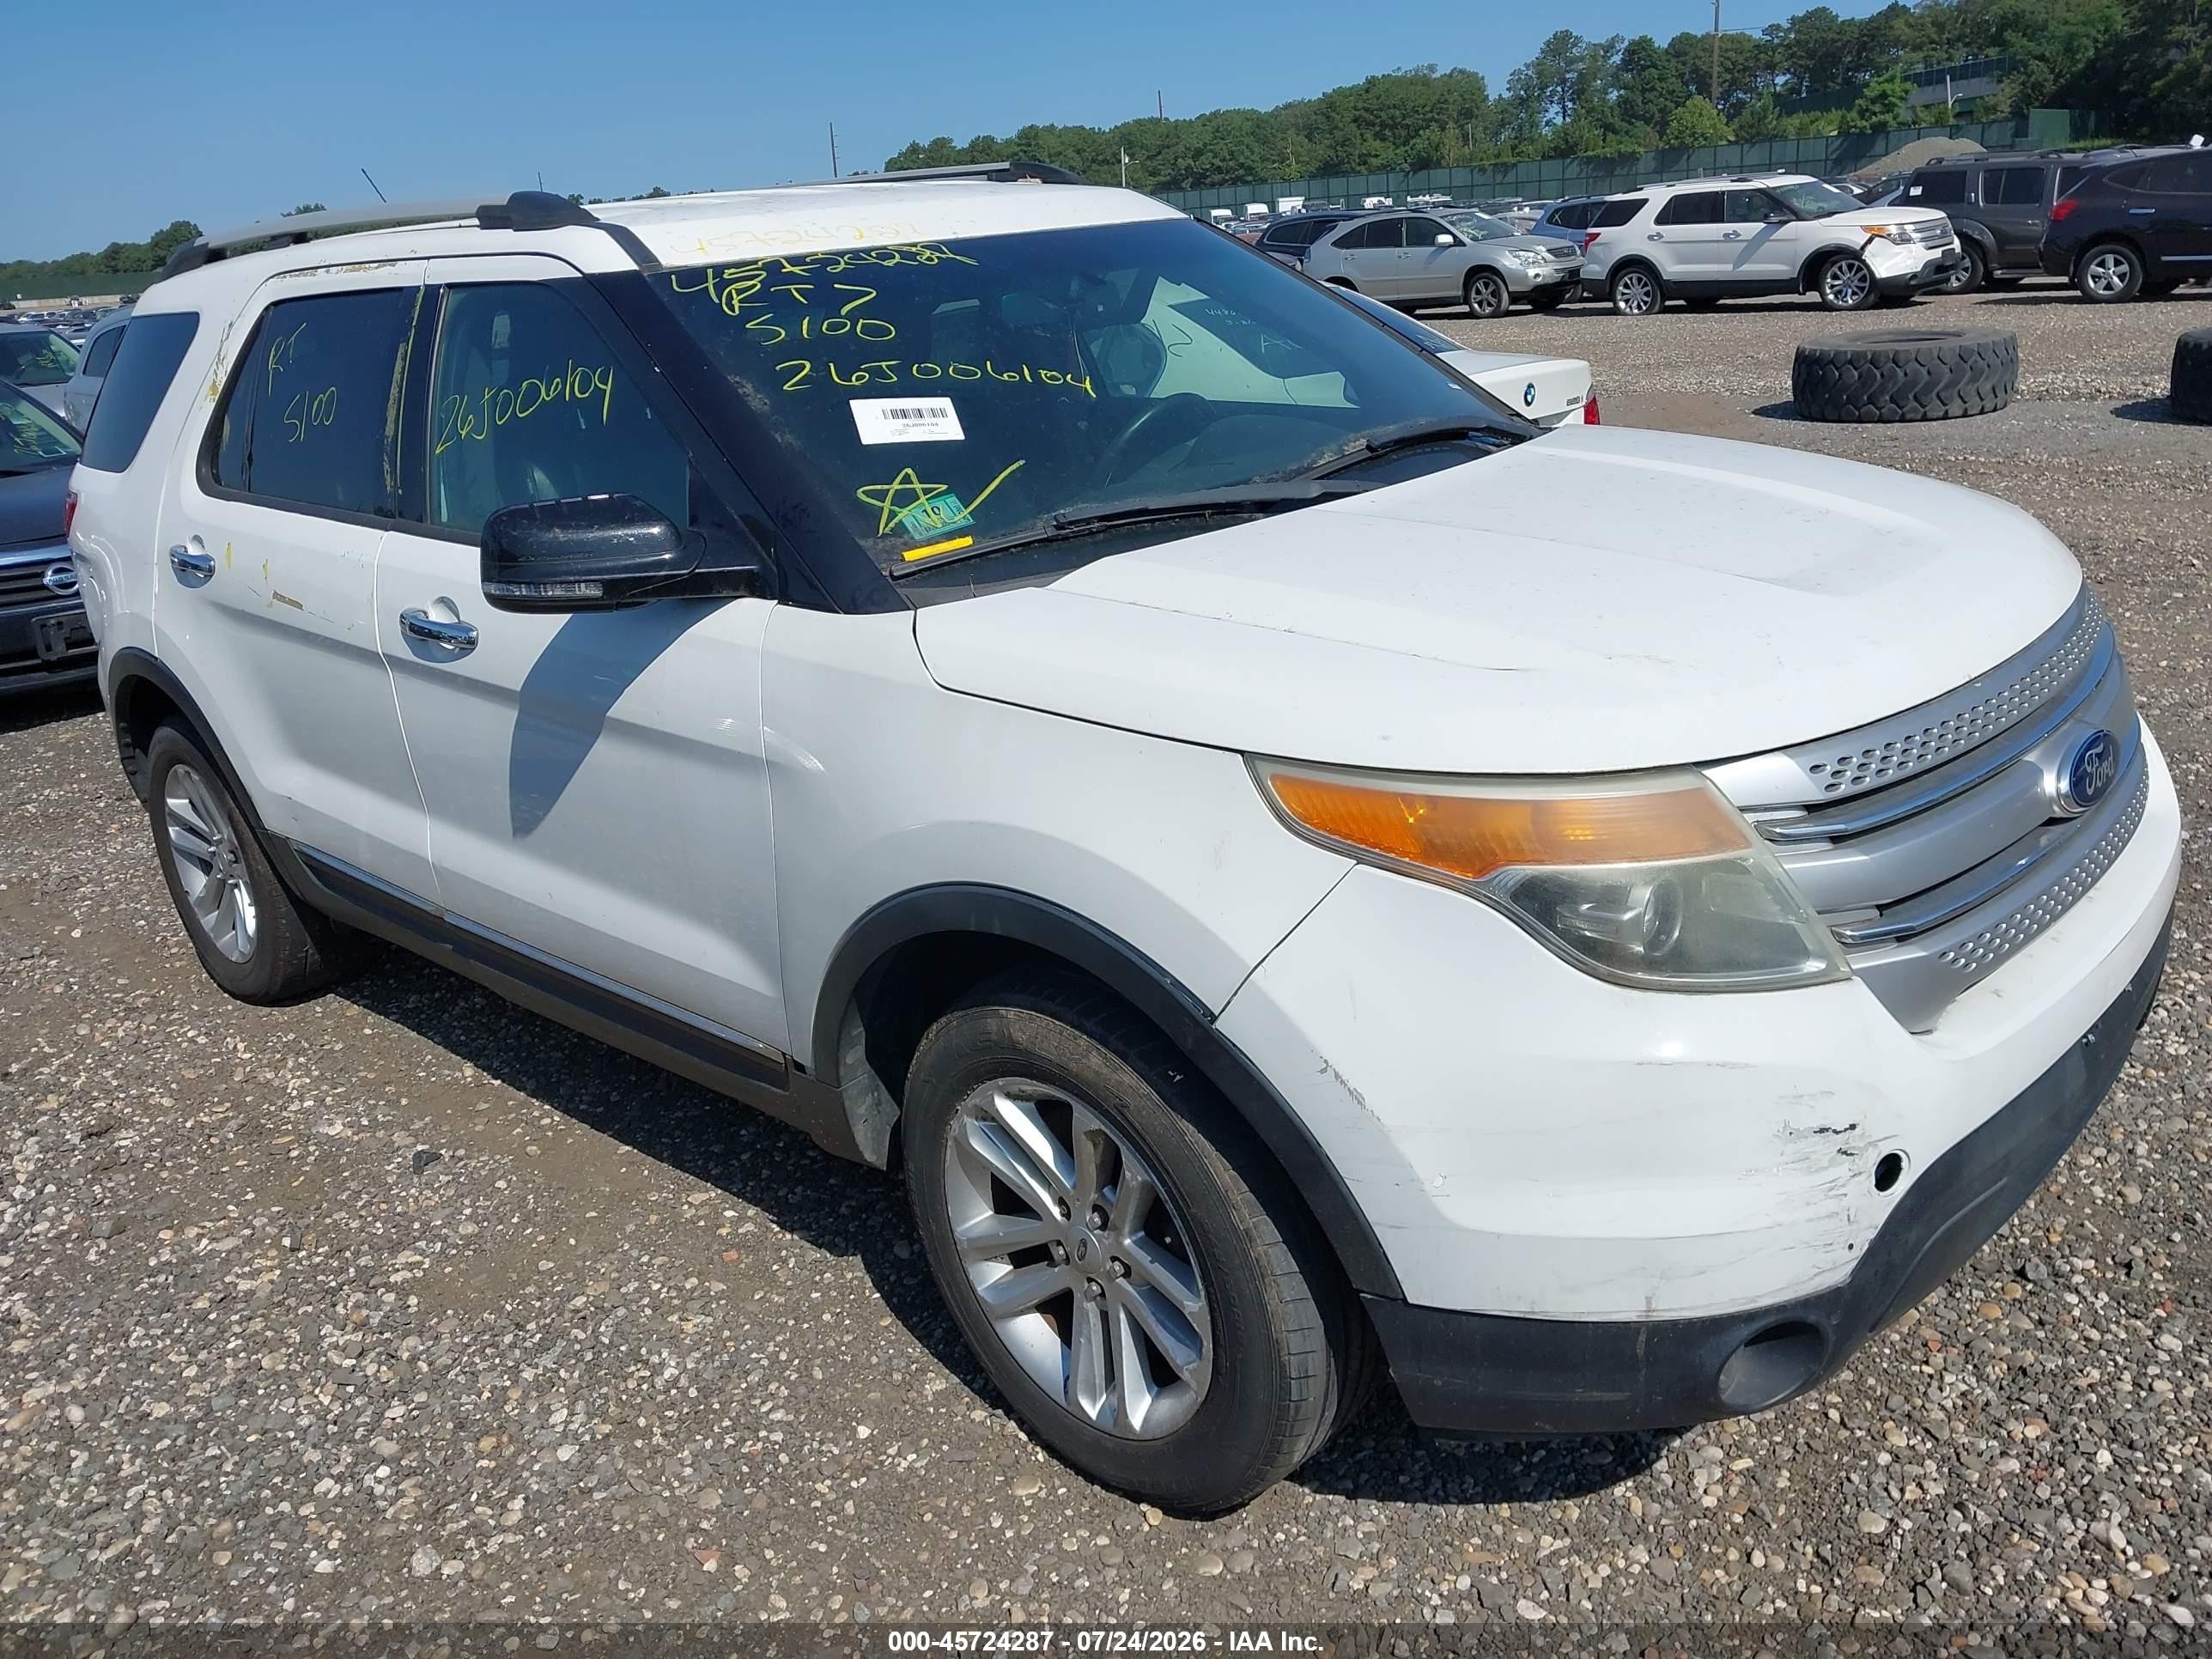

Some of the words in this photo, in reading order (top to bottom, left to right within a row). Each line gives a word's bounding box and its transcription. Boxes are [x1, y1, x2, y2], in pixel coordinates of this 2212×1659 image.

[775, 359, 1097, 398] 26J006104
[435, 359, 614, 454] 26J006104
[2084, 742, 2115, 796] Ford
